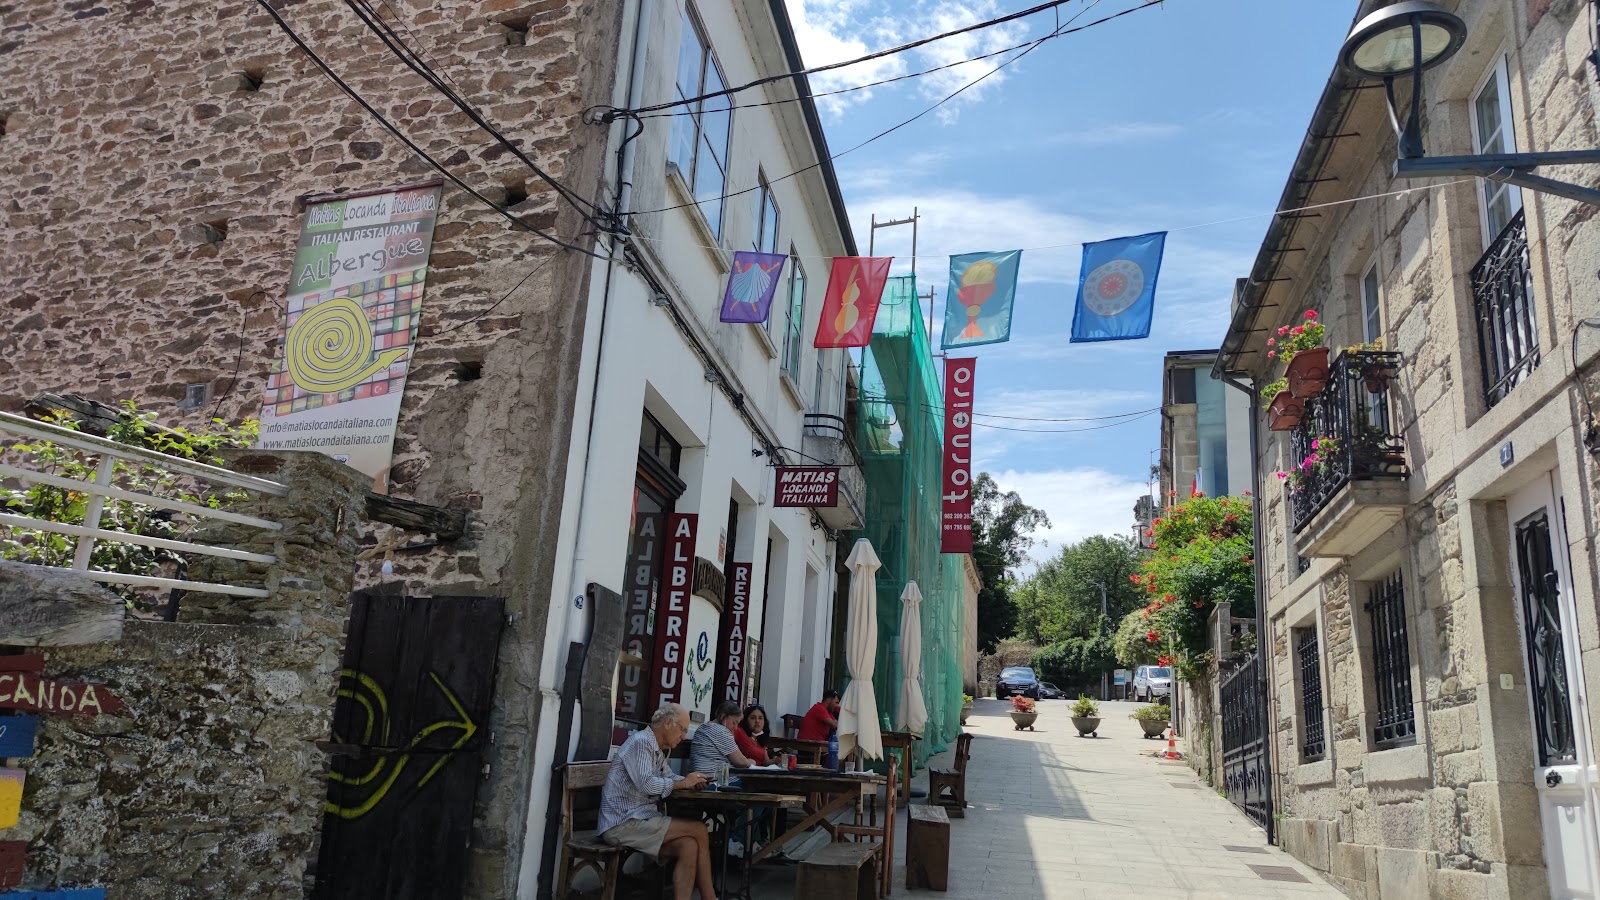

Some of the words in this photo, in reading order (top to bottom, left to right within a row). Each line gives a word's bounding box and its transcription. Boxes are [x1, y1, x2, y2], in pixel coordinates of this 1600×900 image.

[307, 203, 341, 228] Matias
[343, 195, 387, 222] Locanda
[390, 192, 436, 215] Italiana
[312, 231, 352, 246] ITALIAN
[353, 222, 420, 242] RESTAURANT
[298, 237, 424, 287] Albergue
[267, 418, 393, 434] info@matiaslocandaitaliana.com
[943, 367, 971, 503] torneiro
[263, 434, 390, 451] www.matiaslocandaitaliana.com
[780, 471, 835, 483] MATIAS
[781, 494, 828, 503] ITALIANA
[782, 484, 828, 493] LOCANDA
[725, 566, 748, 703] RESTAURAN
